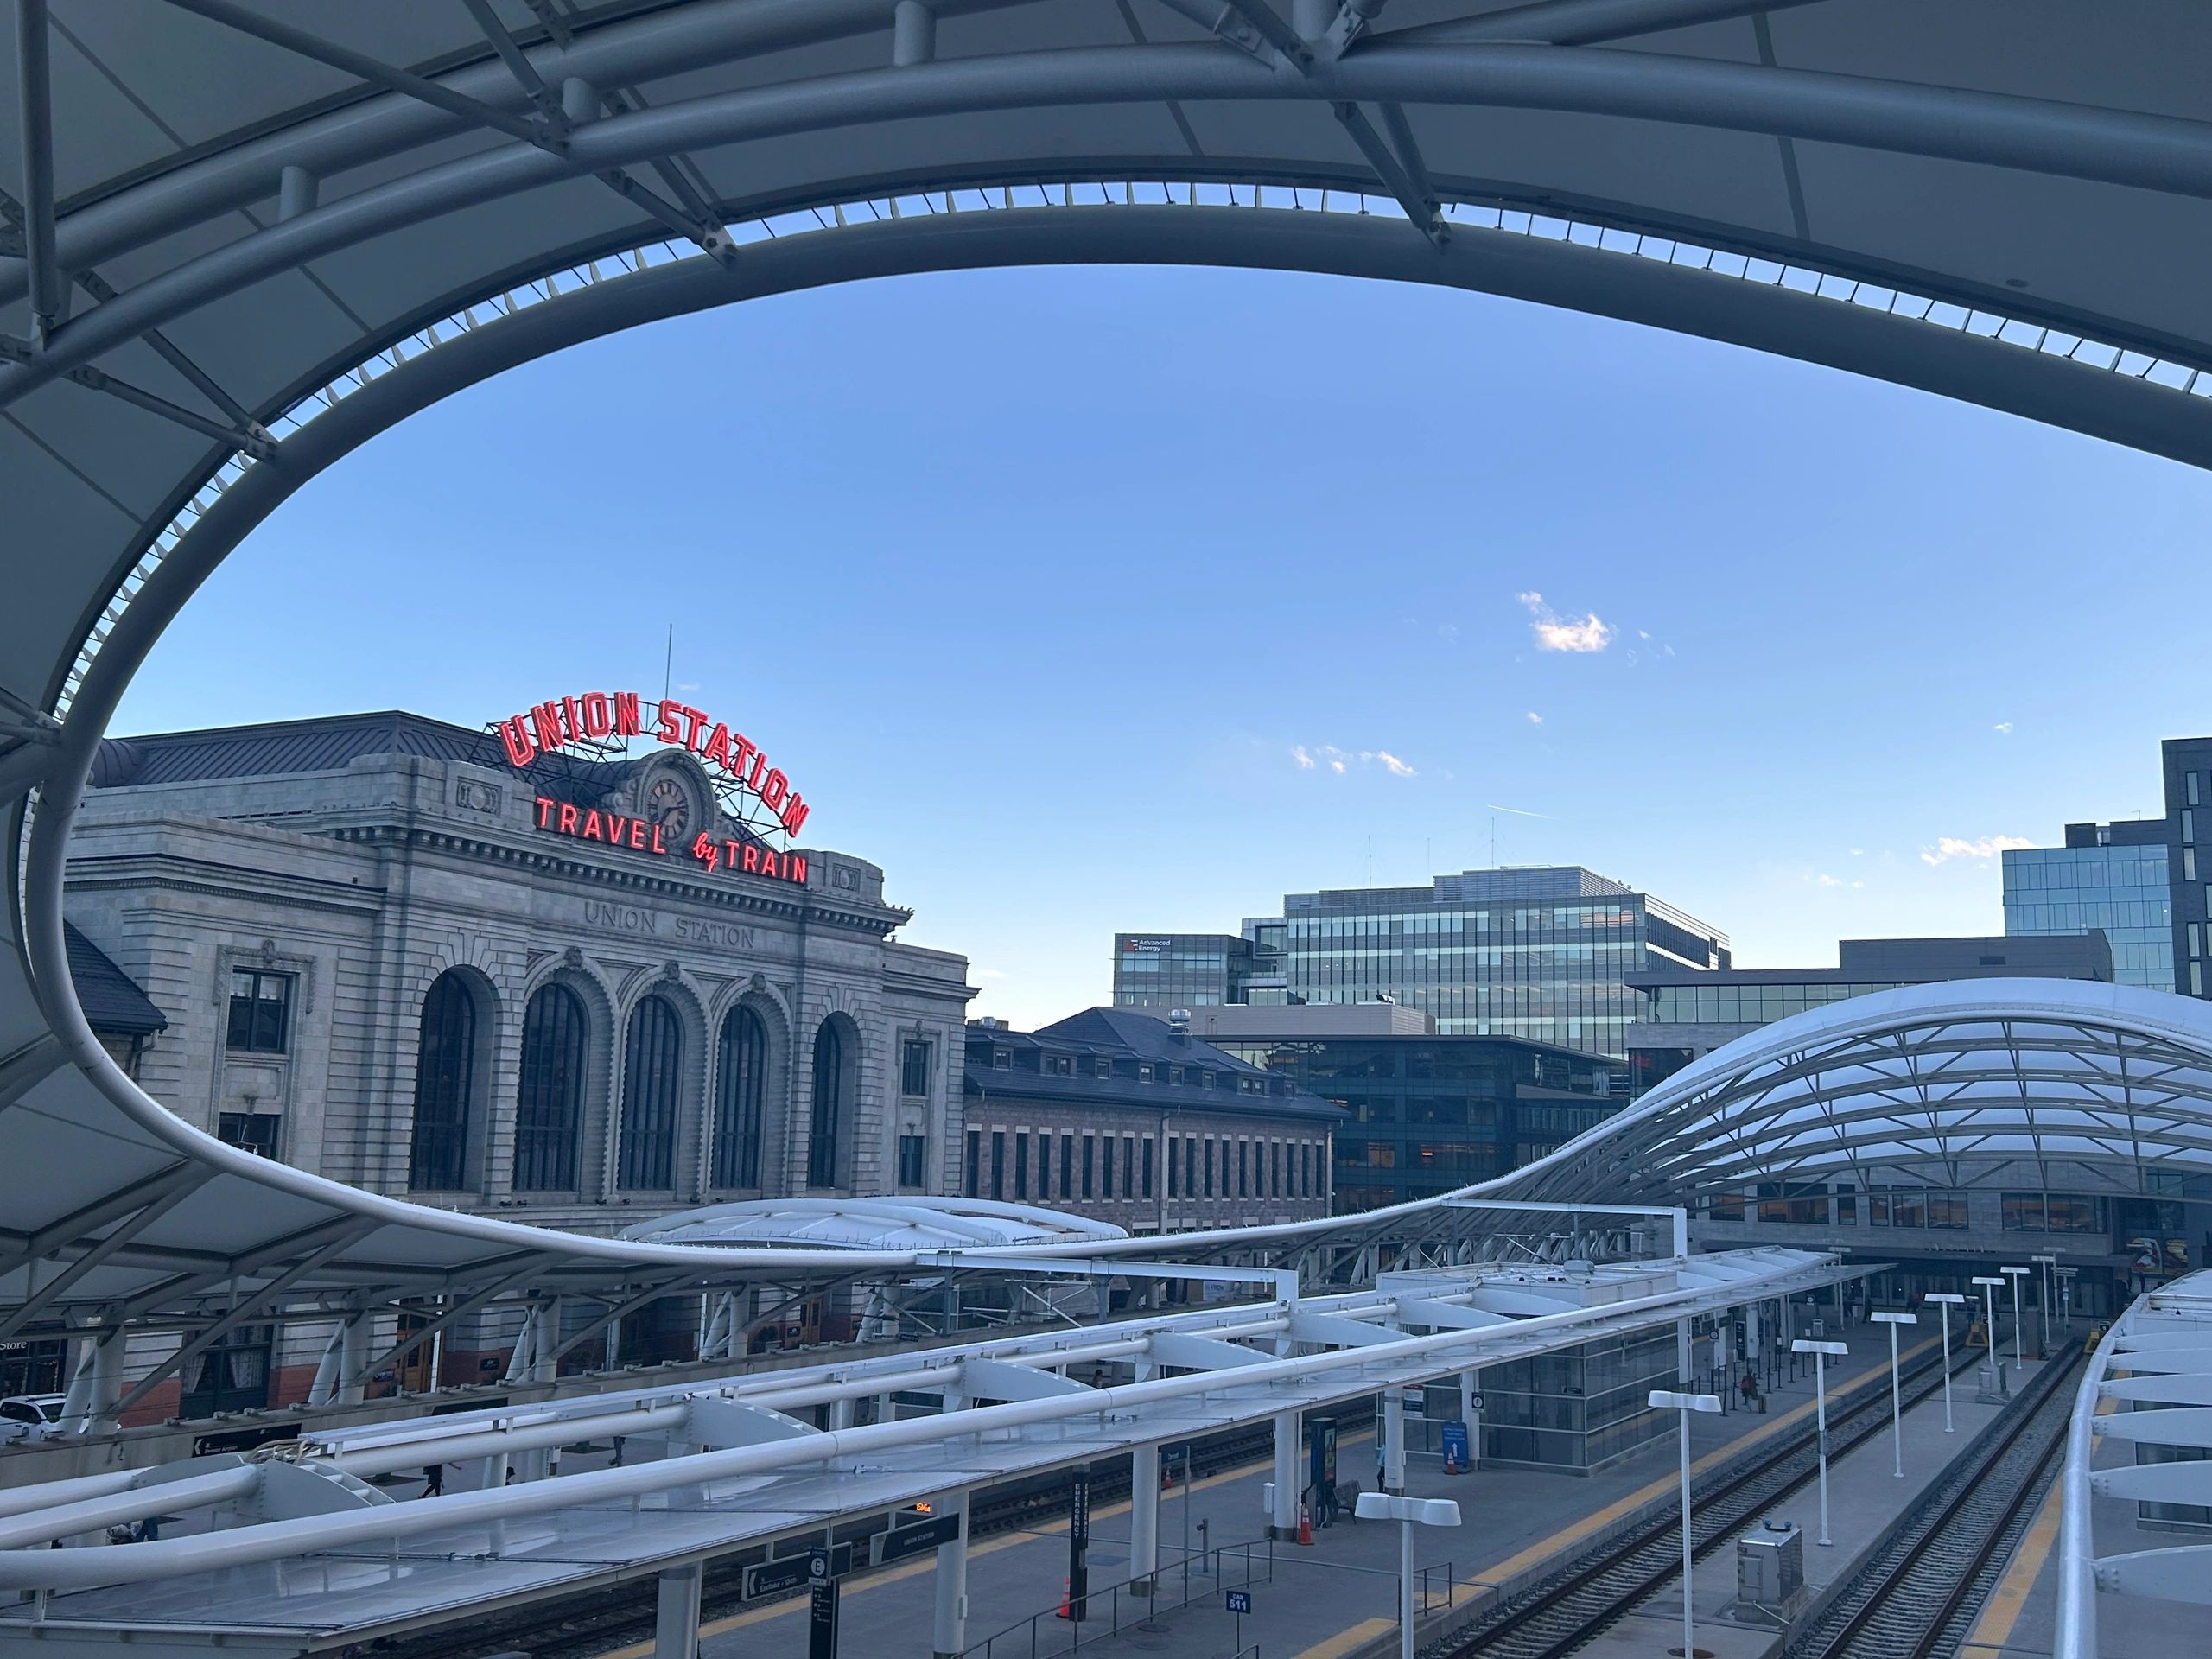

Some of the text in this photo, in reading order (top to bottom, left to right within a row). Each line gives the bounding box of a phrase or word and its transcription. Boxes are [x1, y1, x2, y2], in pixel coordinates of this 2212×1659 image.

[499, 692, 640, 766] UNION
[657, 700, 810, 837] STATION
[535, 795, 666, 855] TRAVEL
[692, 831, 719, 873] by
[723, 840, 807, 883] TRAIN
[584, 901, 754, 948] UNION STATION
[1229, 1599, 1247, 1611] 511
